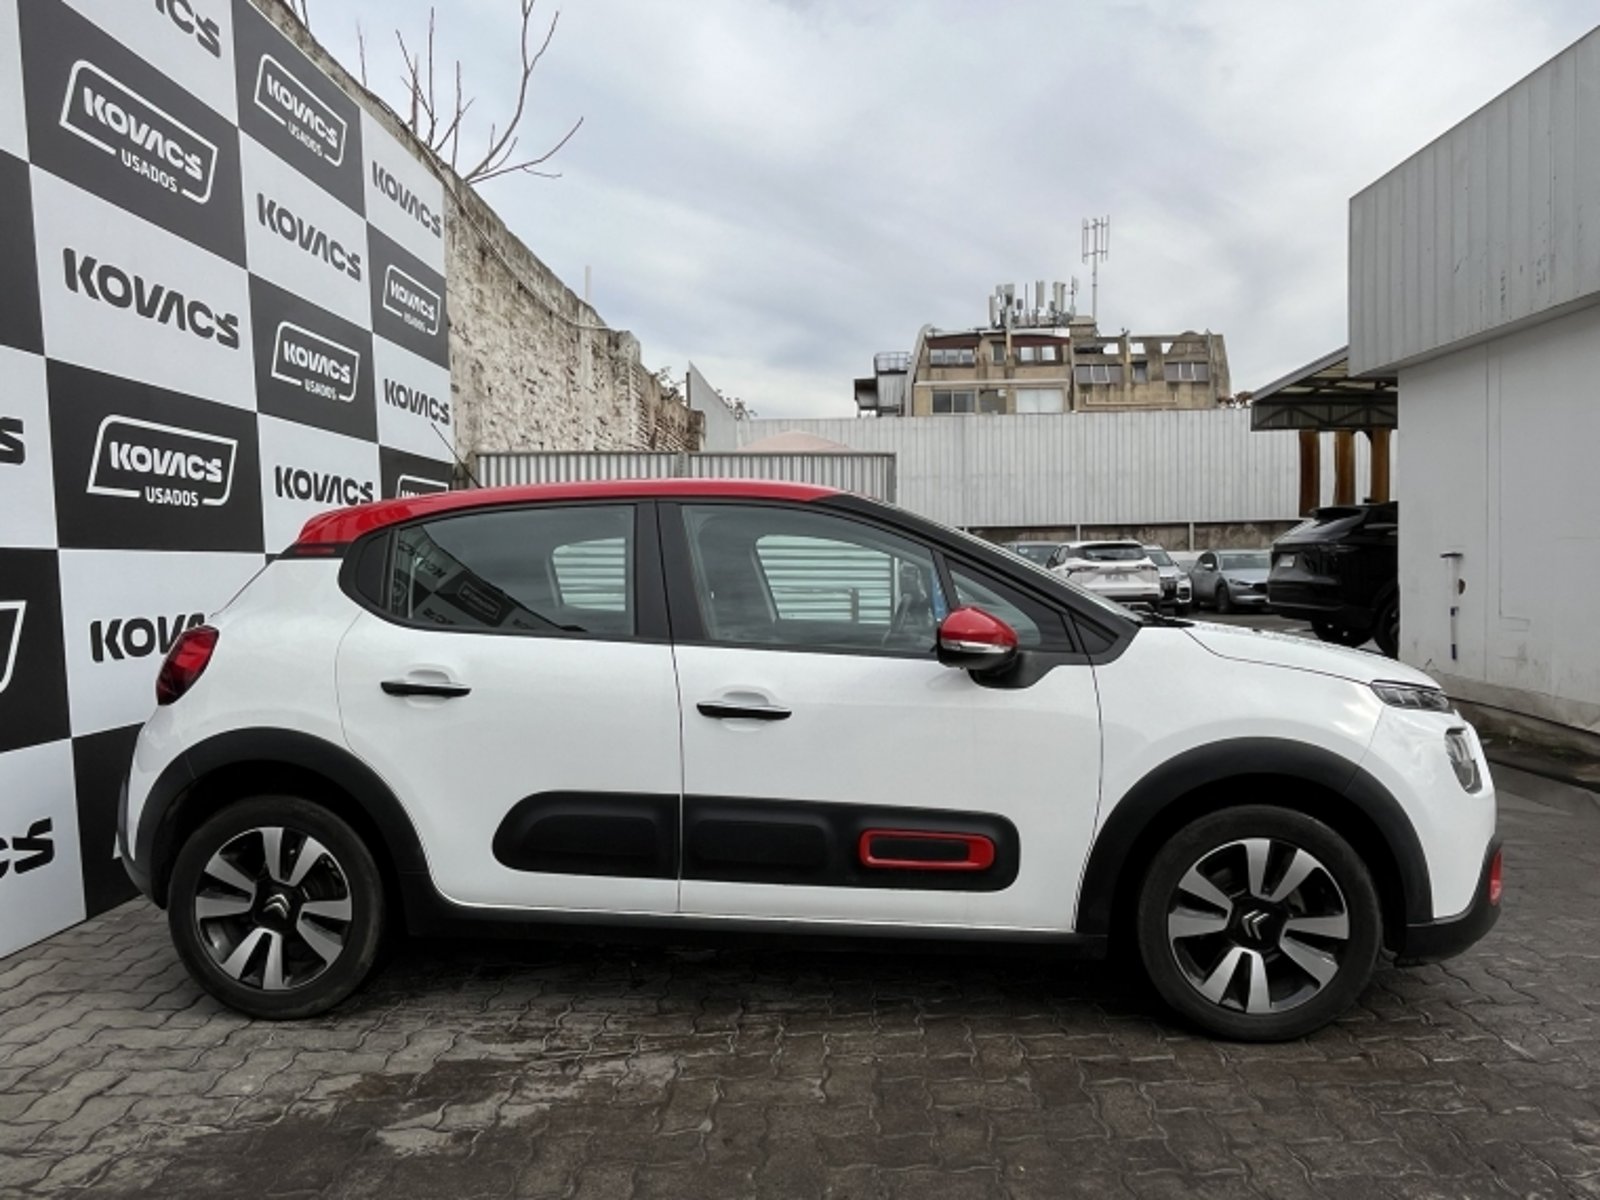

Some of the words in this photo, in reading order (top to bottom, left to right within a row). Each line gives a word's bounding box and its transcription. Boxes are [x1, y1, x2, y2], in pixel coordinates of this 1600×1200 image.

[84, 86, 203, 181] KOVACS
[266, 74, 338, 148] KOVACS
[121, 149, 178, 193] USADOS
[372, 160, 441, 239] KOVACS
[257, 193, 361, 281] KOVACS
[63, 247, 239, 350] KOVACS
[390, 279, 435, 321] KOVACS
[283, 340, 351, 384] KOVACS
[384, 378, 450, 425] KOVACS
[110, 441, 222, 483] KOVACS
[145, 486, 198, 507] USADOS
[275, 465, 373, 506] KOVACS
